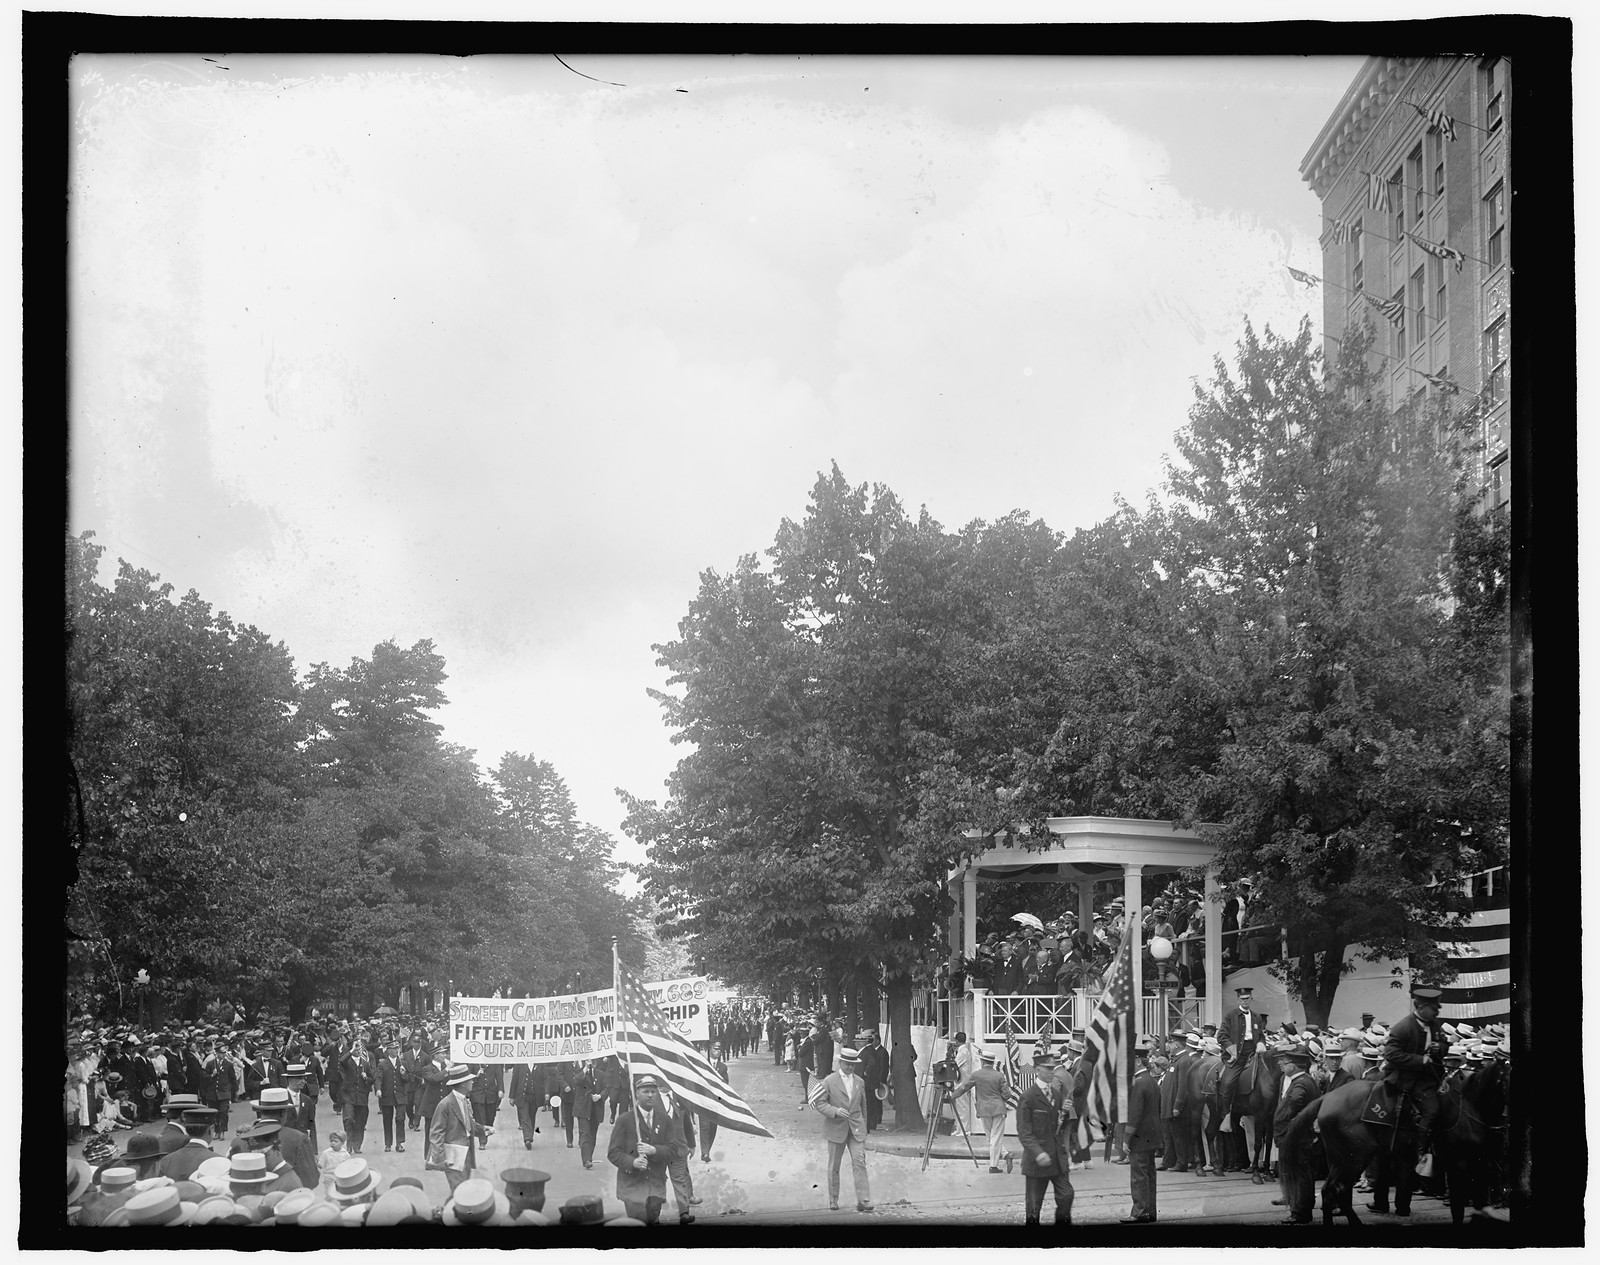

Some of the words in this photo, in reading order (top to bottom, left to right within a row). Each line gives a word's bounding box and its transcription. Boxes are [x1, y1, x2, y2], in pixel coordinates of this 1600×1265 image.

[449, 1001, 509, 1022] STREET
[512, 1002, 546, 1022] CAR
[549, 997, 587, 1021] MEN'S
[587, 995, 614, 1016] UNI
[667, 981, 708, 1003] 689
[455, 1024, 525, 1040] FIFTEEN
[532, 1020, 597, 1040] HUNDRED
[464, 1041, 514, 1058] OUR
[517, 1041, 558, 1057] MEN
[560, 1039, 593, 1056] ARE
